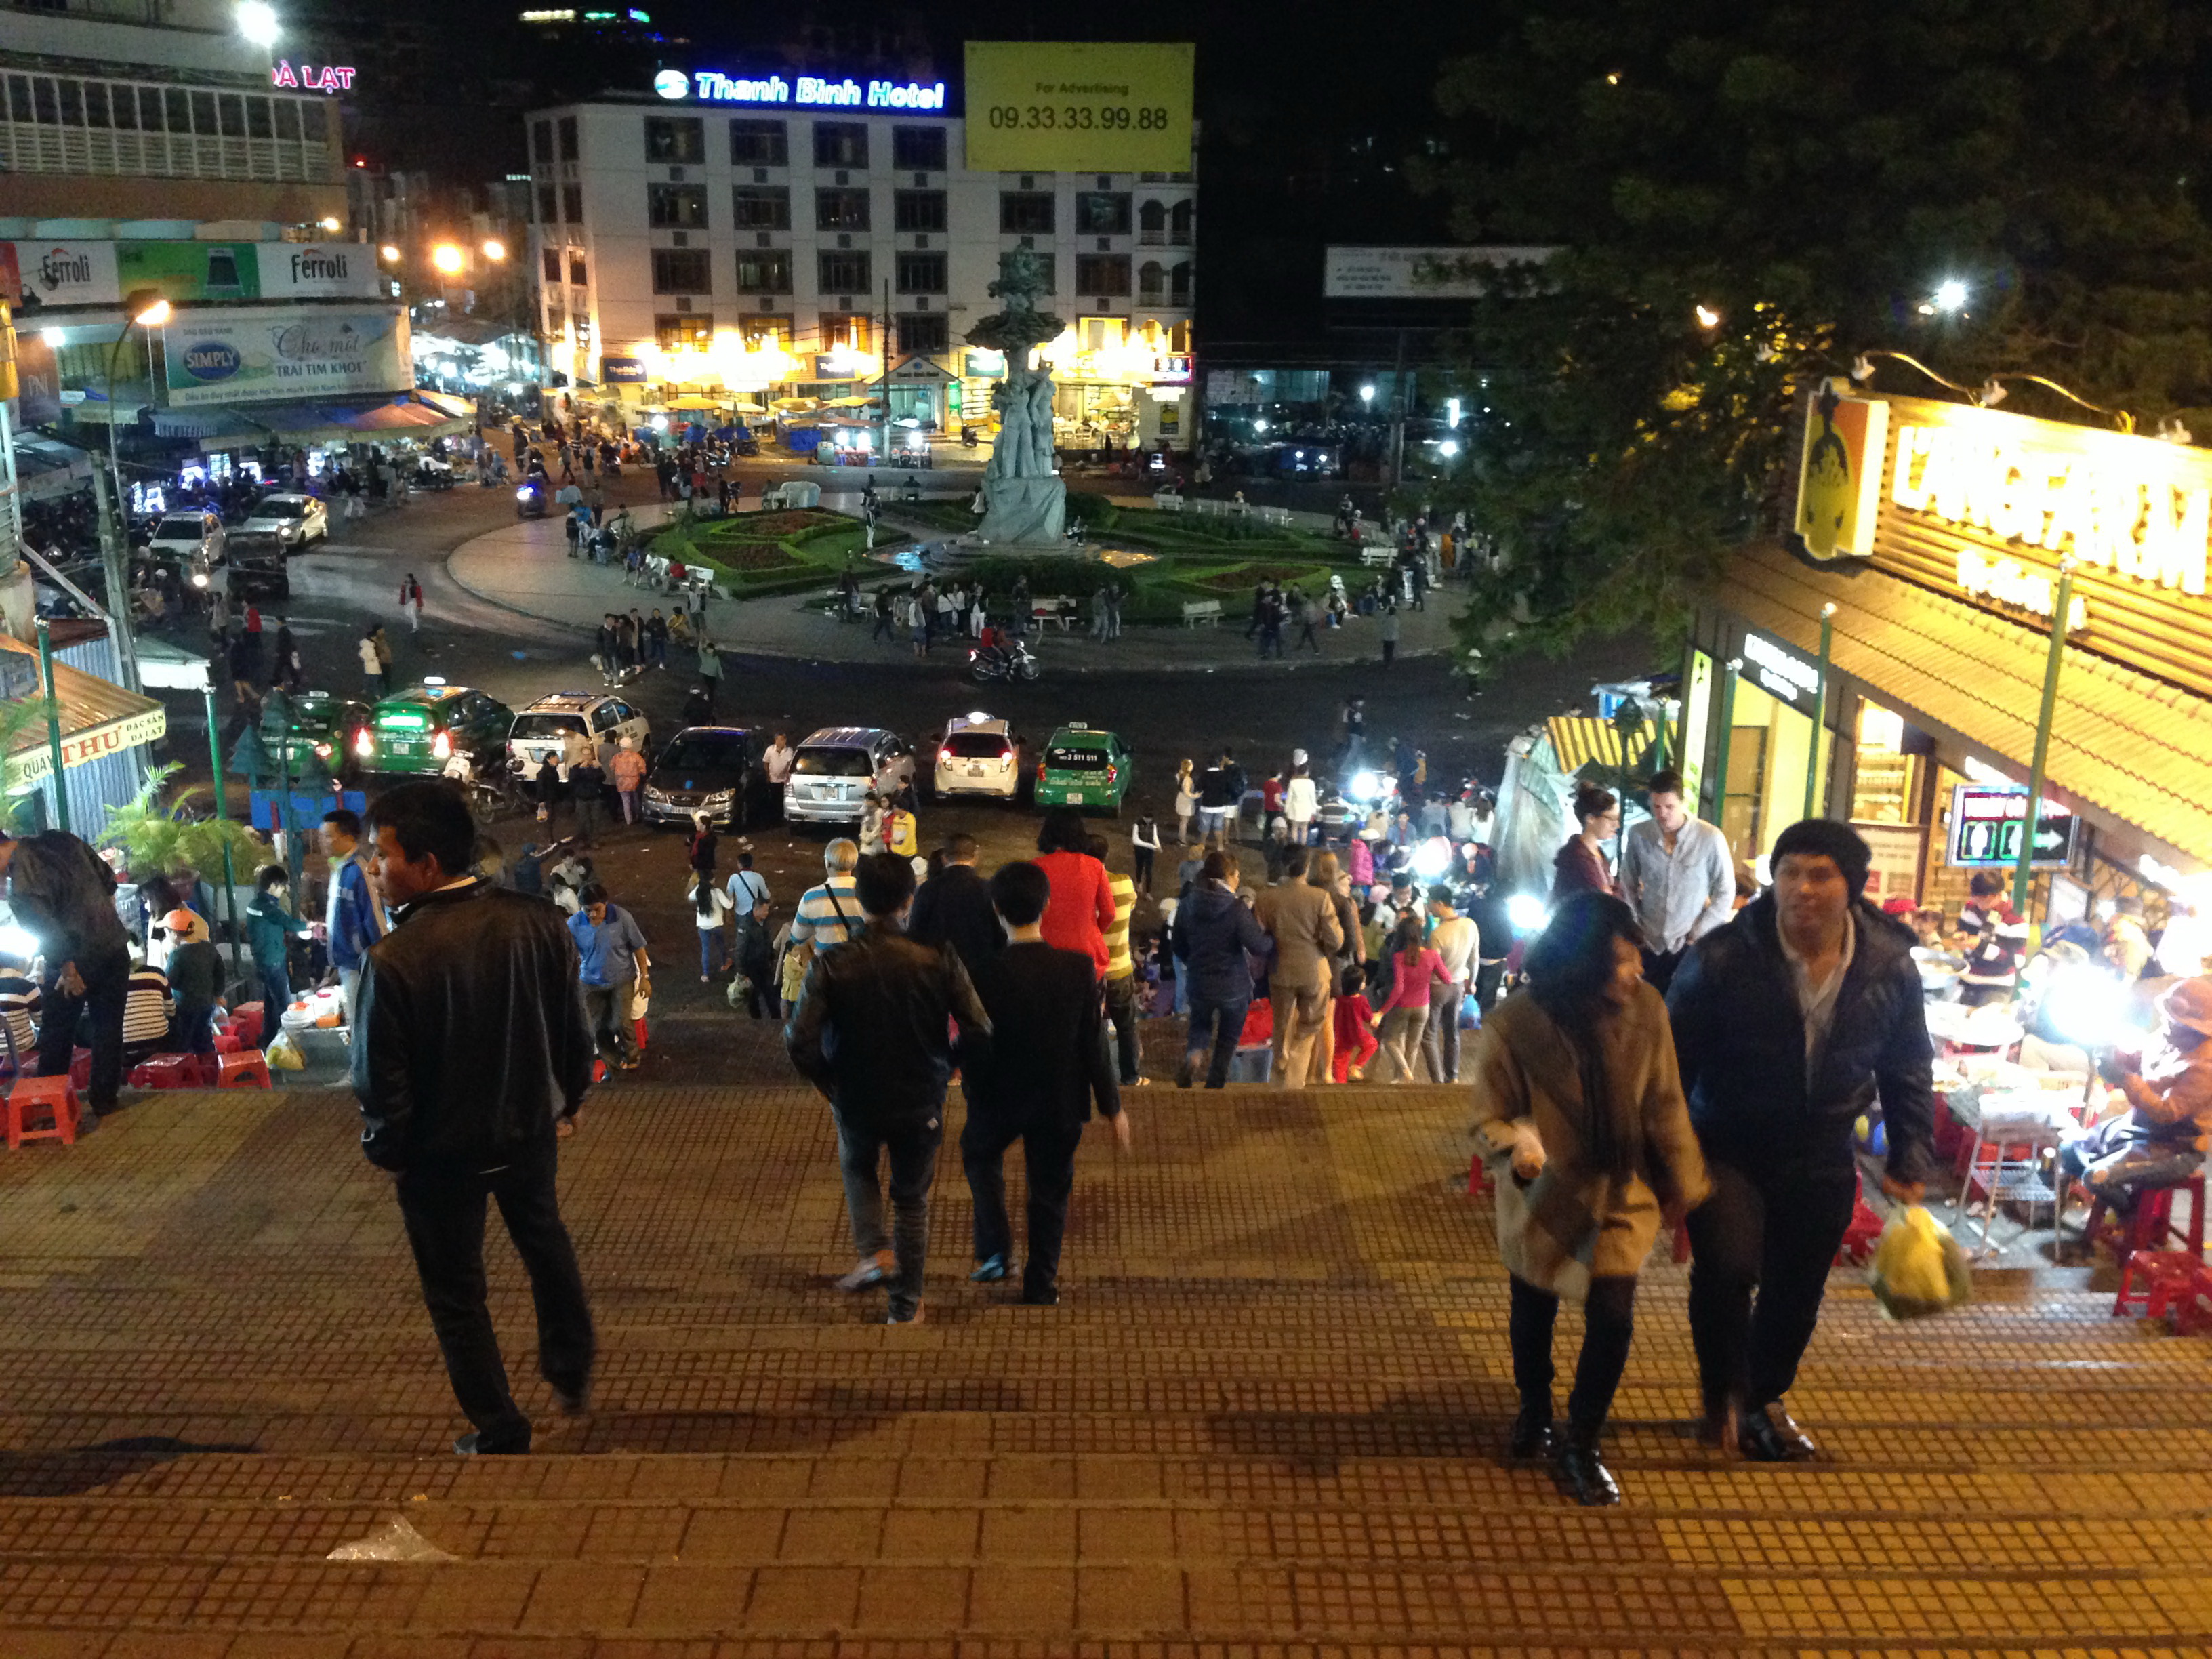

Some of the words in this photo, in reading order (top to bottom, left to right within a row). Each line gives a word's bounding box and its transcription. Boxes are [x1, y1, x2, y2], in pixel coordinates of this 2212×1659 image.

[301, 66, 356, 94] LẠT
[695, 72, 788, 102] Thanh
[867, 81, 945, 108] Hotel
[1036, 83, 1055, 92] For
[1059, 83, 1130, 96] Advertising
[989, 106, 1168, 130] 09.33.33.99.88
[41, 255, 91, 282] Ferroli
[291, 253, 348, 283] Ferroli
[186, 351, 235, 369] SIMPLY
[306, 364, 327, 375] TIM
